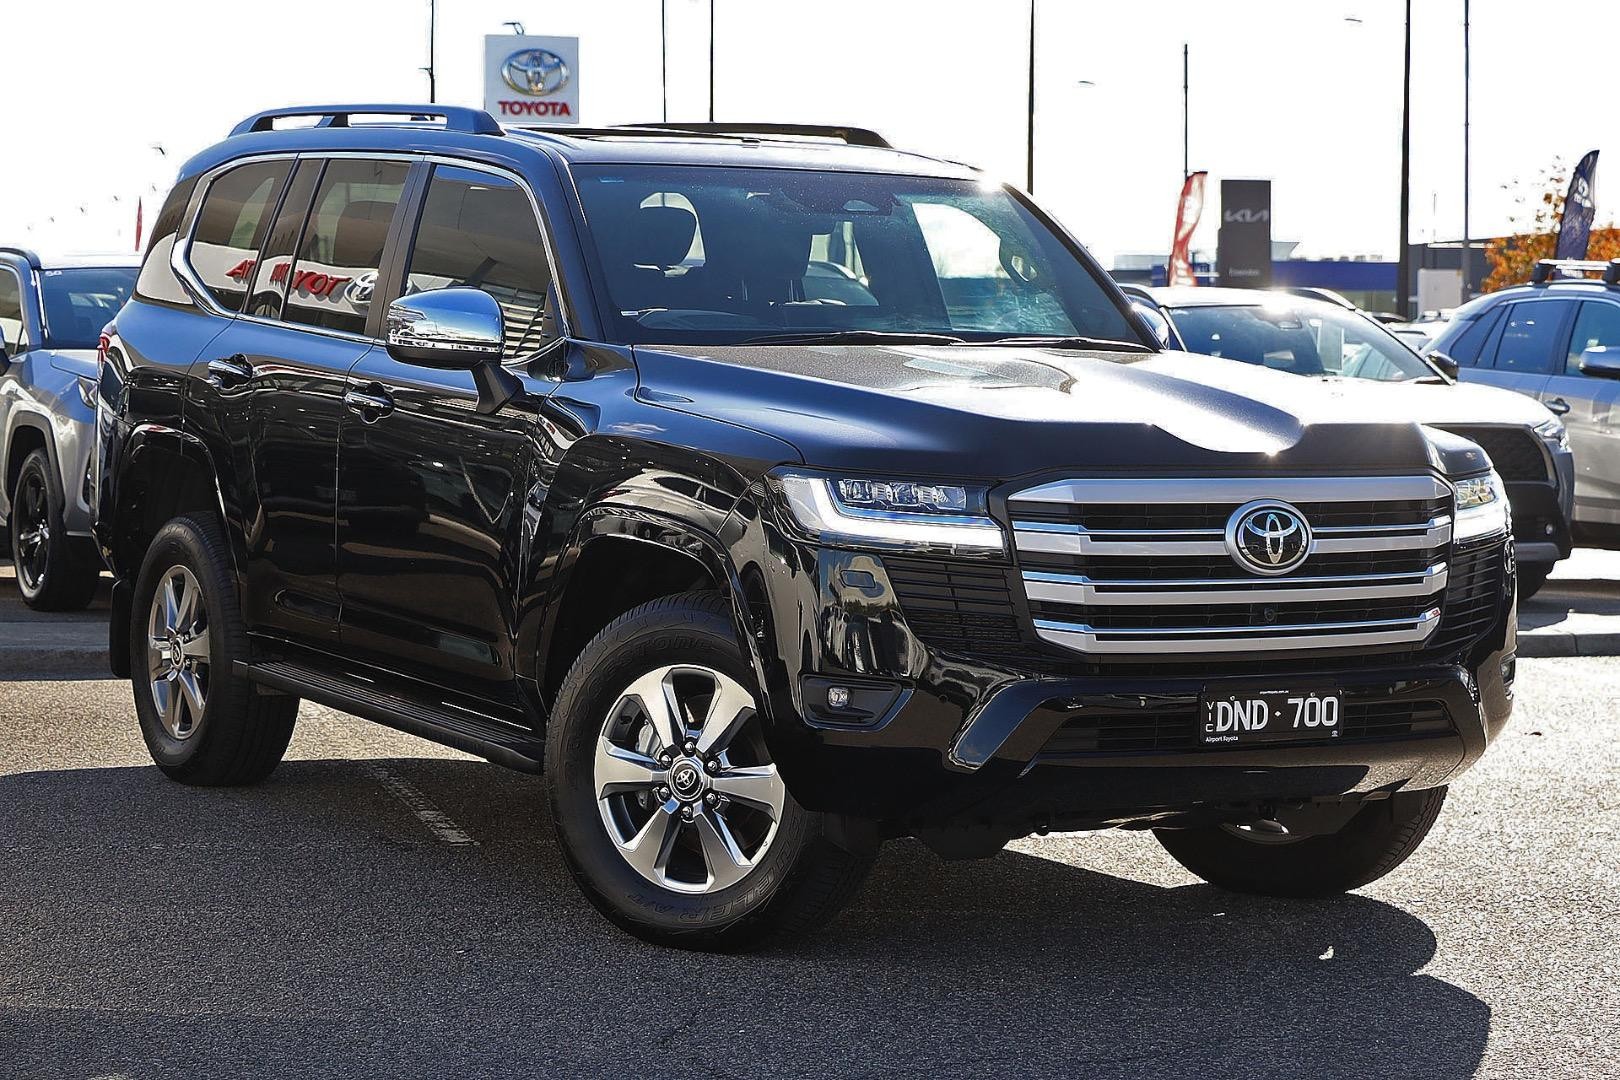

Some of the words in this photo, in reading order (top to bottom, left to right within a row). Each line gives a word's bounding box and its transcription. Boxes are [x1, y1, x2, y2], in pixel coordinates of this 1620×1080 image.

[498, 101, 570, 116] TOYOTA
[1216, 699, 1269, 732] DND
[1287, 696, 1339, 728] 700
[1223, 735, 1239, 743] Toyota
